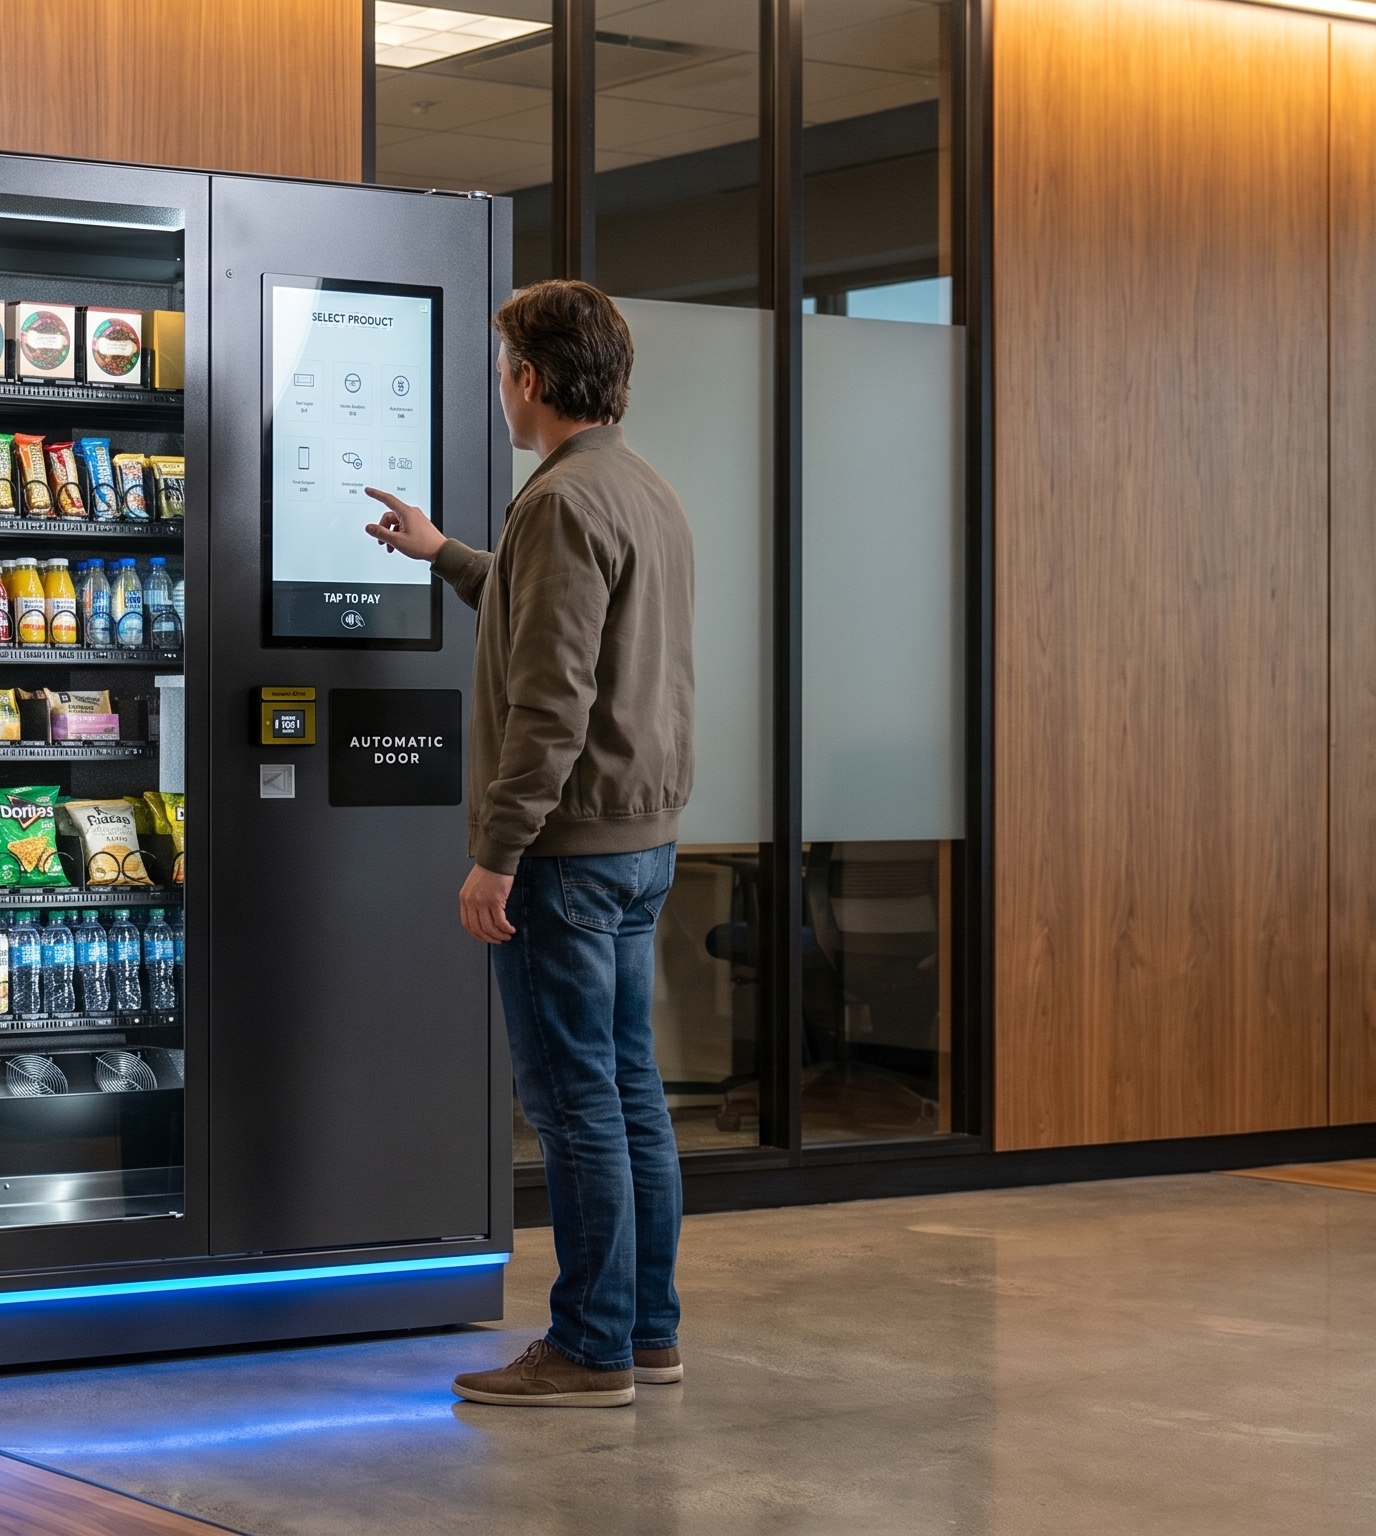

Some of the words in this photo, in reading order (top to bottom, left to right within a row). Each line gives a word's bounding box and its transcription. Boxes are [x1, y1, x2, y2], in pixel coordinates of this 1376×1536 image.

[312, 312, 345, 323] SELECT
[348, 314, 394, 327] PRODUCT
[324, 593, 343, 603] TAP
[345, 593, 359, 604] TO
[361, 593, 380, 604] PAY
[350, 736, 443, 748] AUTOMATIC
[374, 753, 419, 764] DOOR
